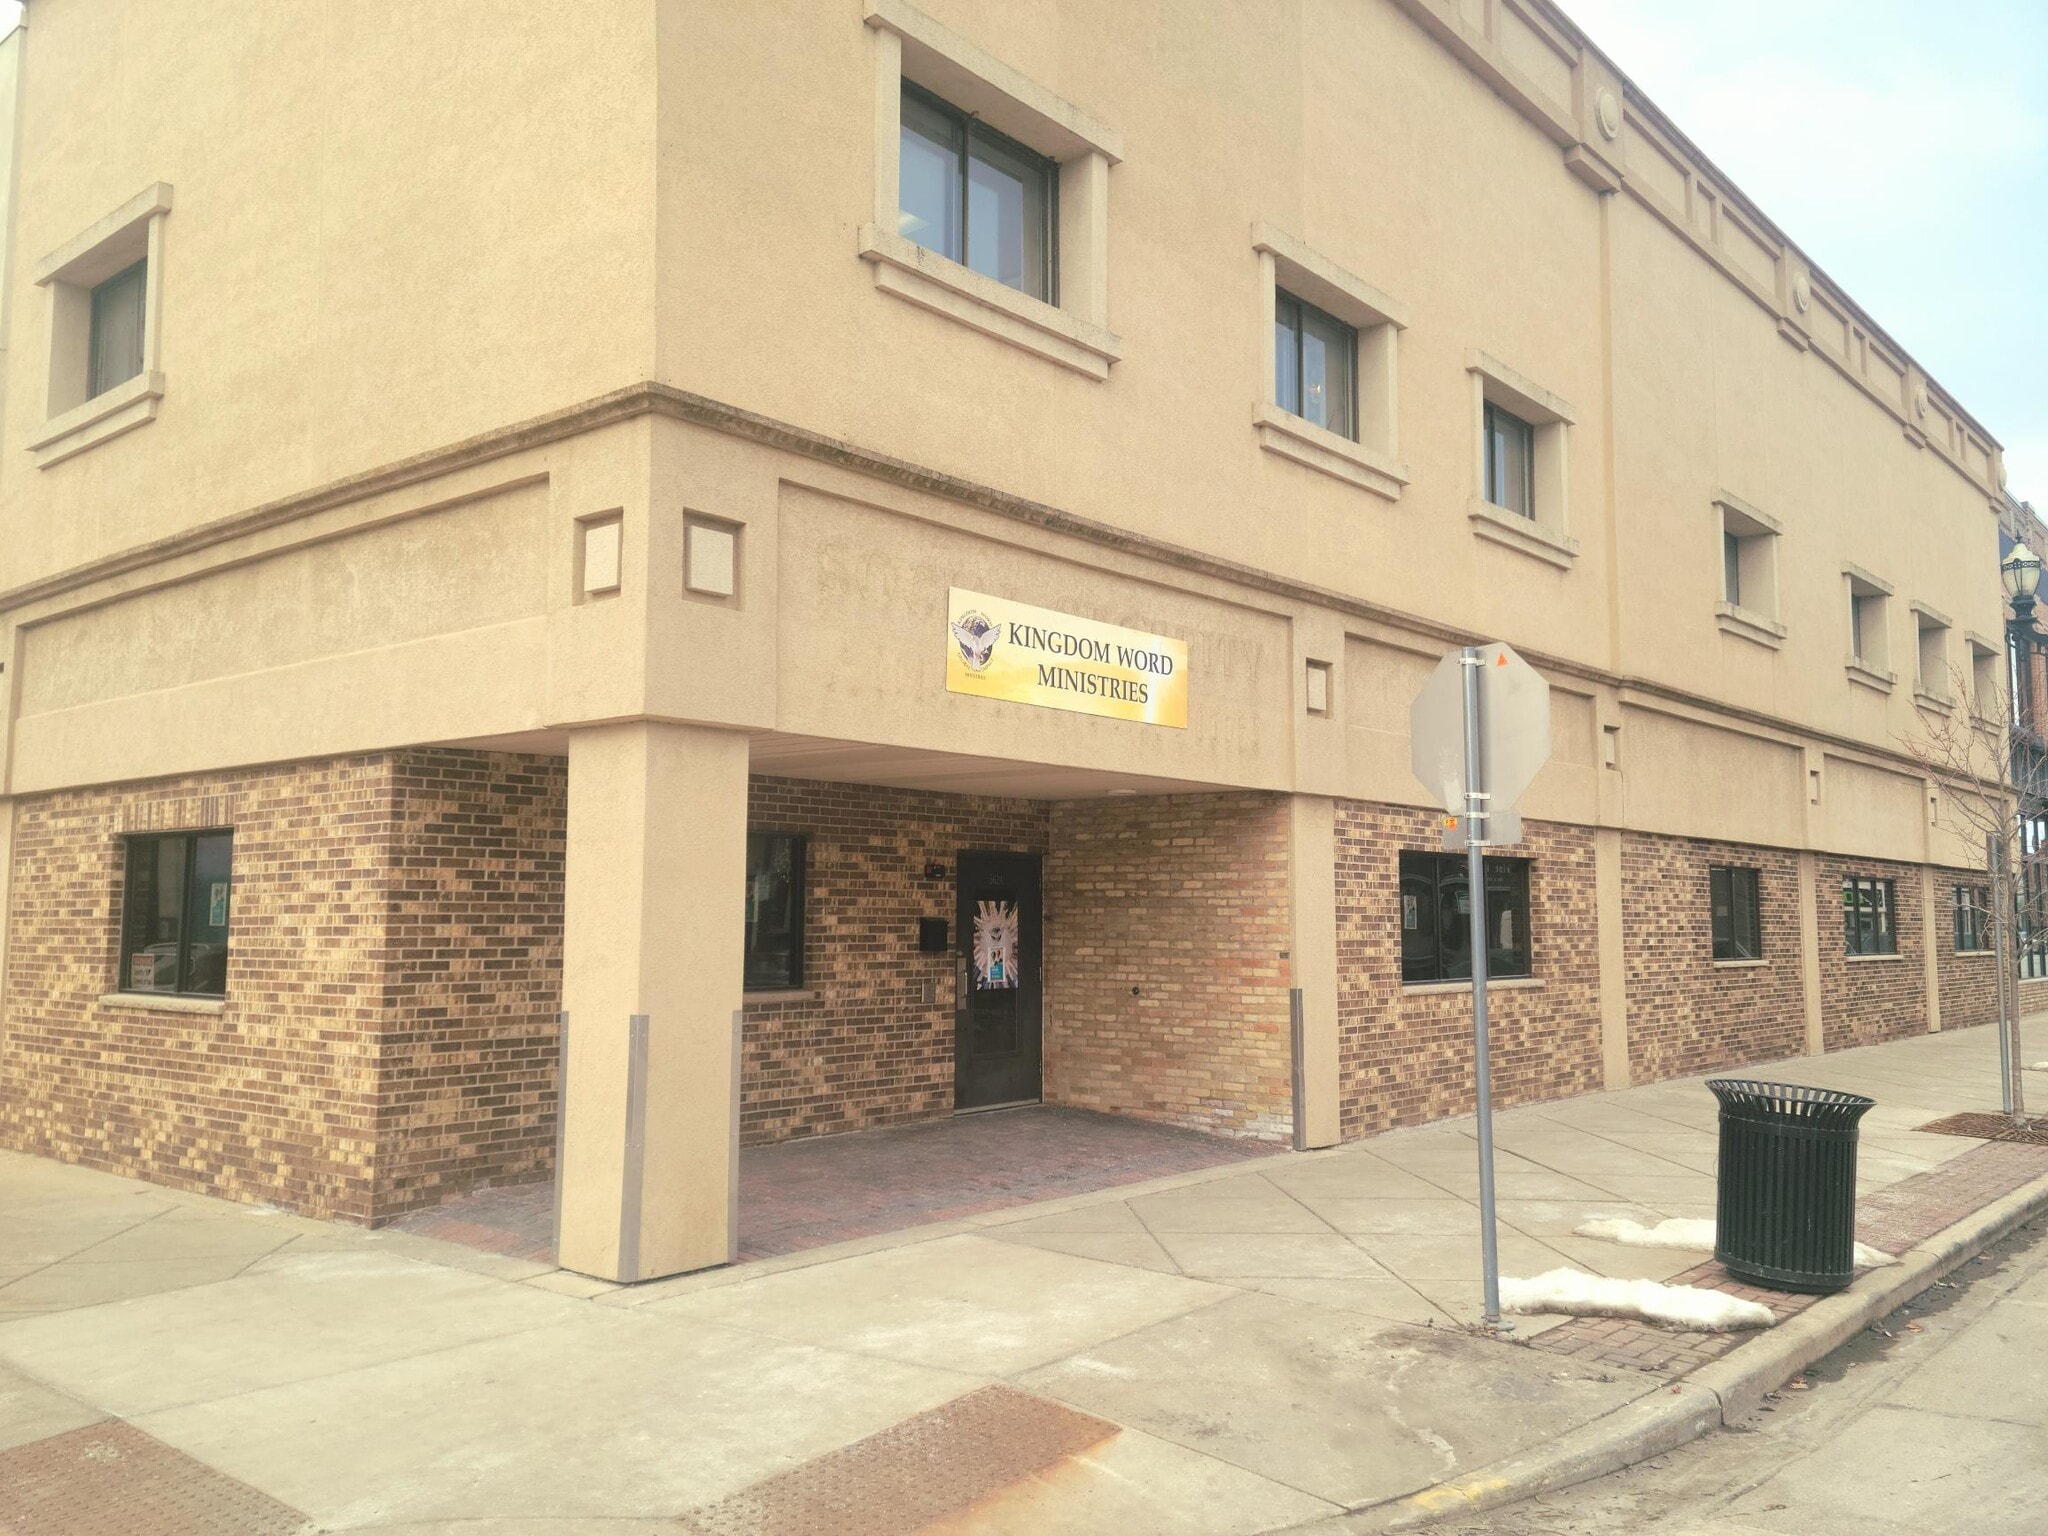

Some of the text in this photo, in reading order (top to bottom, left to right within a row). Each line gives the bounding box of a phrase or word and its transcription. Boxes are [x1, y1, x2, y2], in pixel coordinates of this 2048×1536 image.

[1008, 622, 1110, 664] KINGDOM
[1116, 645, 1174, 676] WORD
[1037, 664, 1149, 704] MINISTRIES
